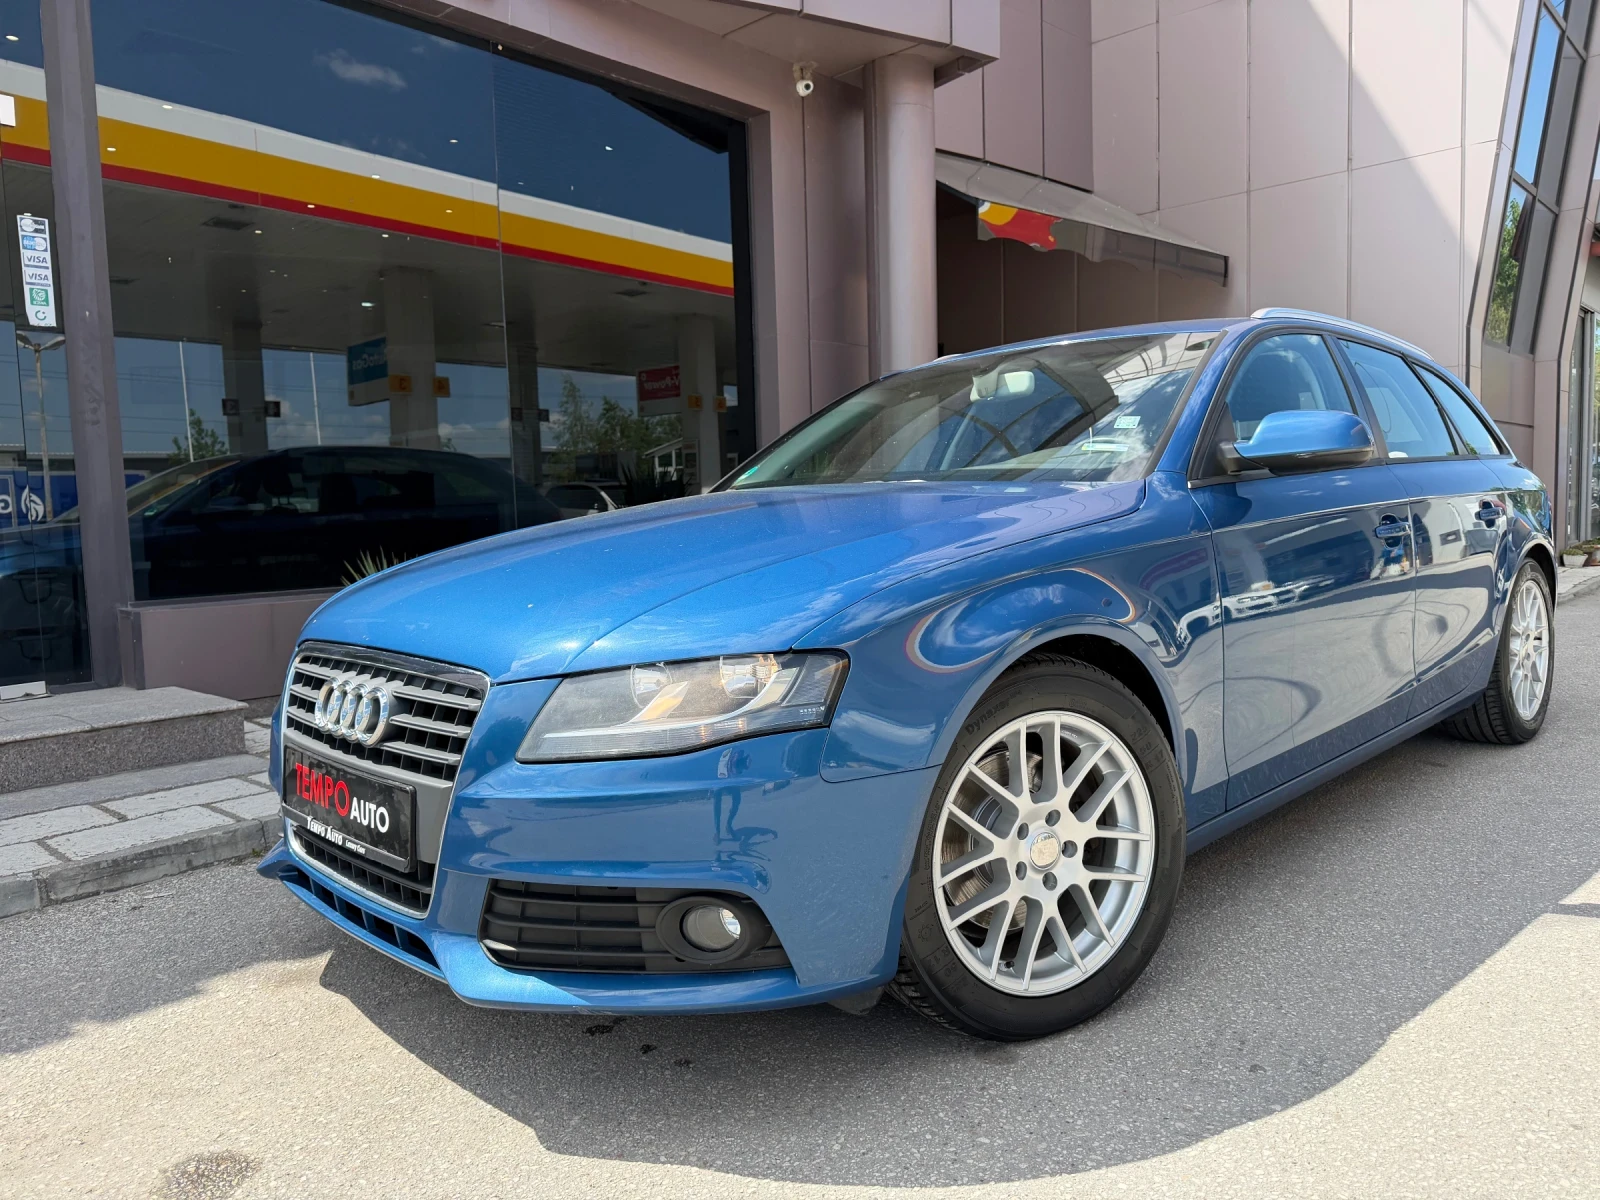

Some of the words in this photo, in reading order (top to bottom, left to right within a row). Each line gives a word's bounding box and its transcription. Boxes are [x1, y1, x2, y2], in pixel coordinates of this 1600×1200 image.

[26, 255, 48, 264] VISA
[28, 272, 49, 281] VISA
[295, 762, 350, 817] TEMPO
[350, 796, 390, 834] AUTO
[306, 815, 326, 837] TEMPO
[325, 826, 343, 846] AUTO
